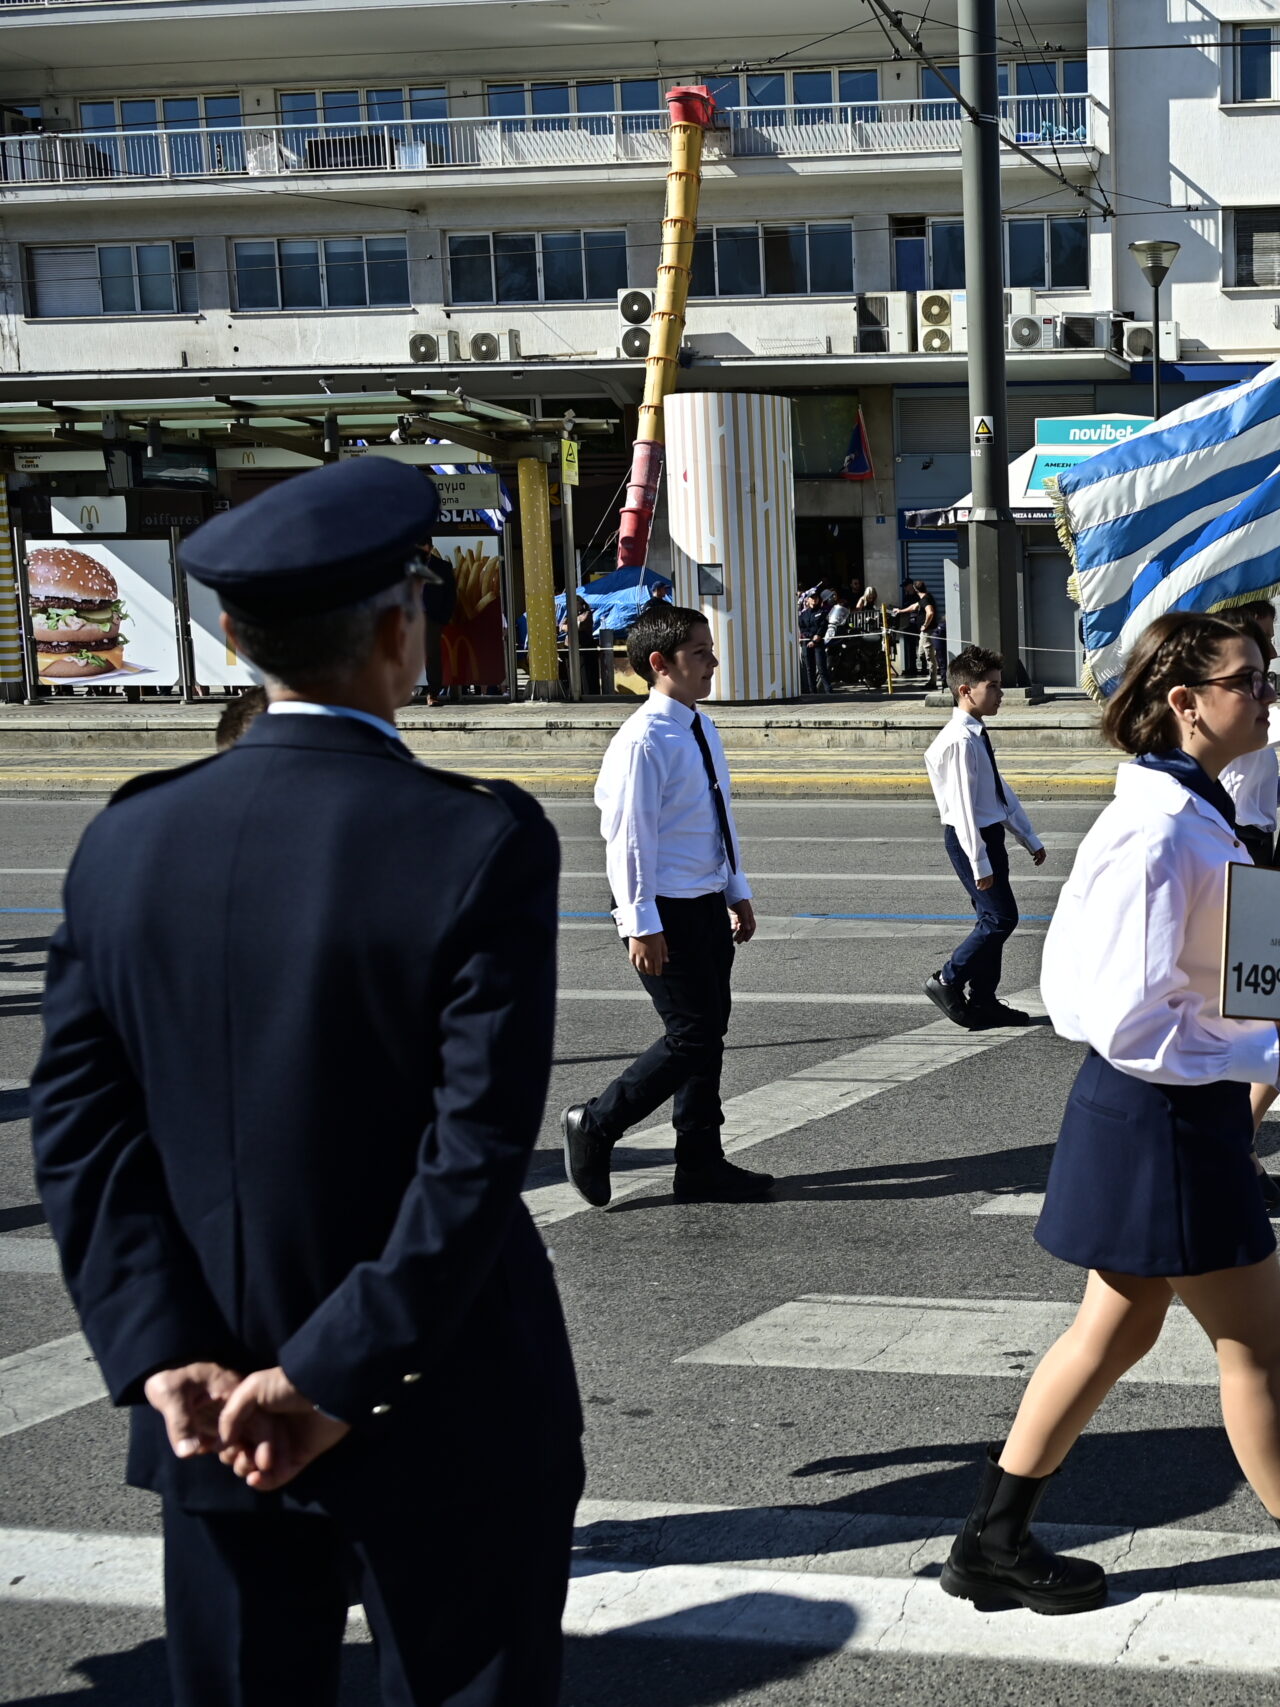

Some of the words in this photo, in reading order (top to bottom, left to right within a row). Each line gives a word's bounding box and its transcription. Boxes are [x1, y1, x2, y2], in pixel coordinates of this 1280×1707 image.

[1069, 424, 1134, 441] novibet
[436, 480, 466, 494] αγμα
[440, 496, 460, 505] gma
[144, 512, 200, 526] oiffures
